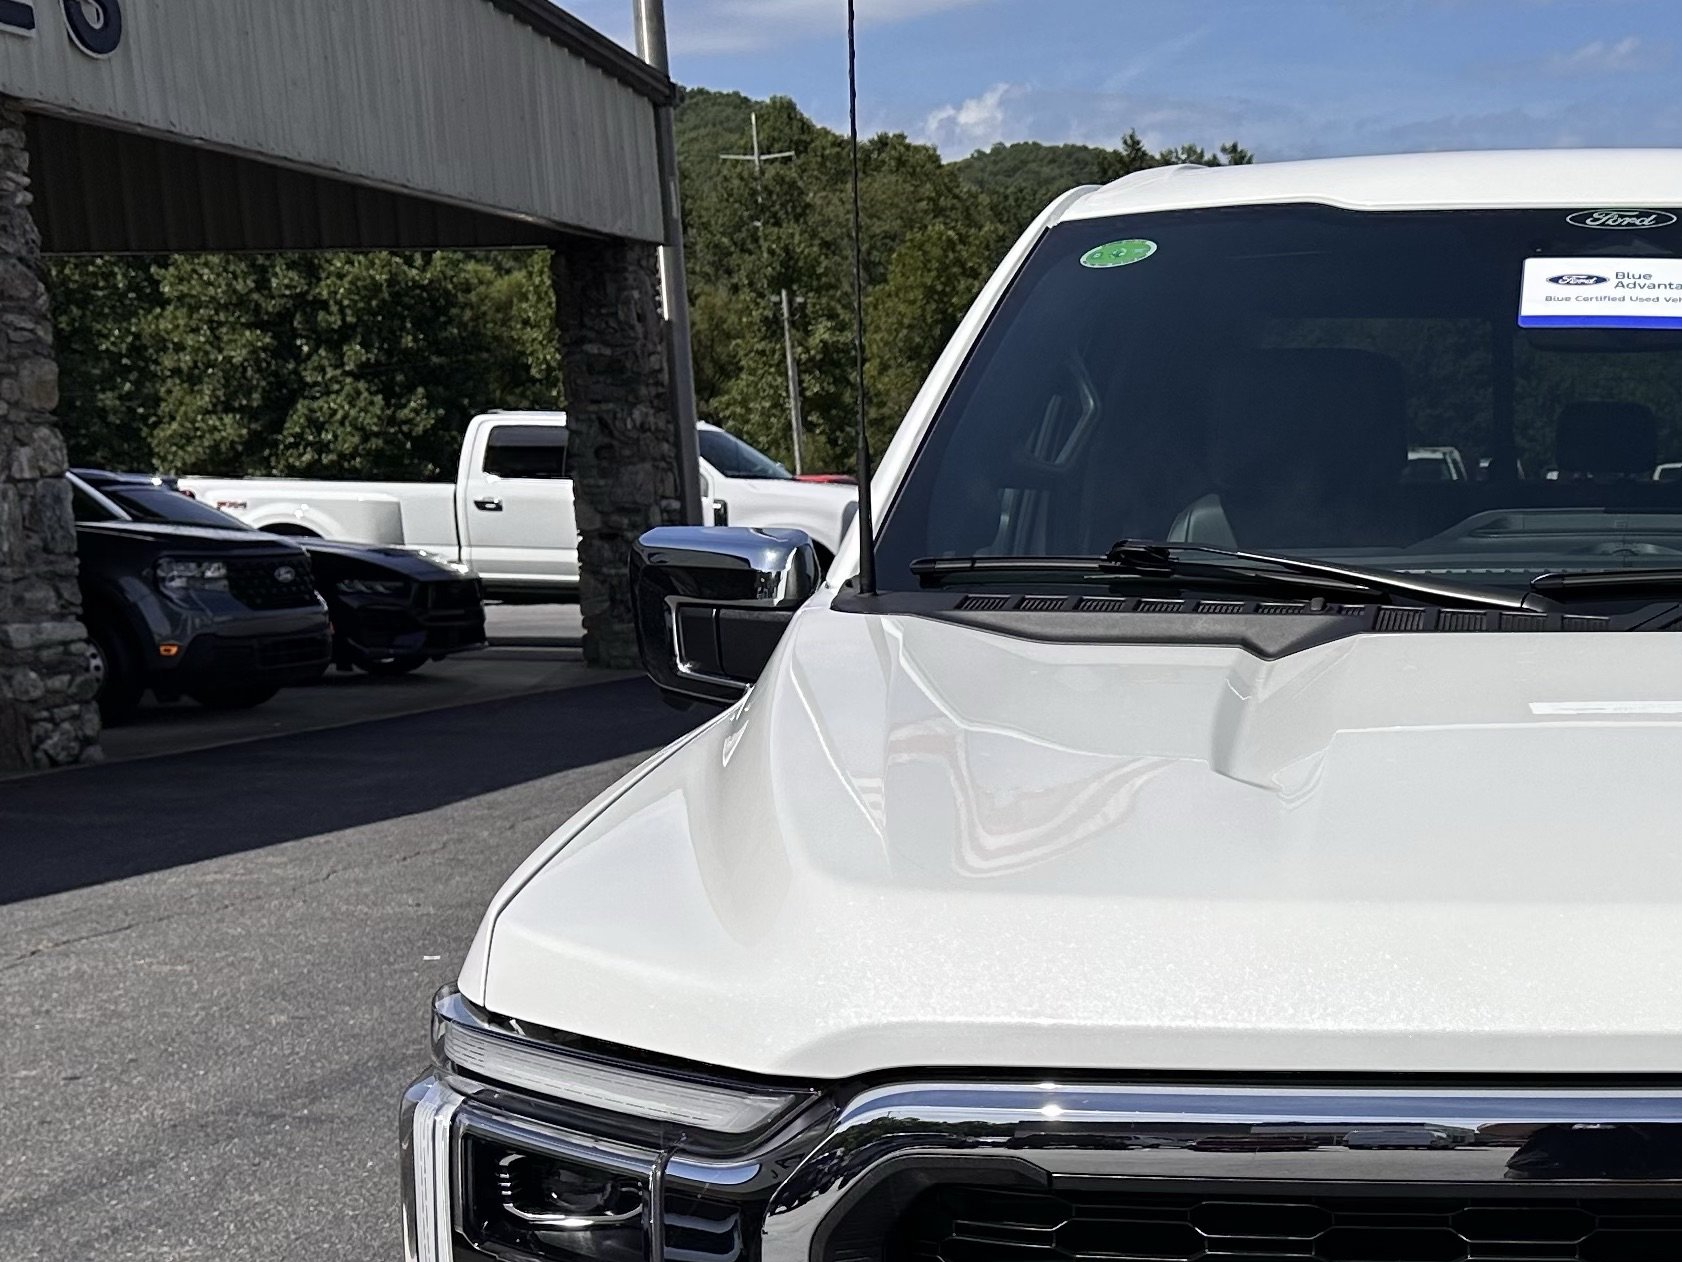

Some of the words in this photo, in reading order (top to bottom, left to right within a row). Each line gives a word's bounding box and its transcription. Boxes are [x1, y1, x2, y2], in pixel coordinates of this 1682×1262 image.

[1585, 209, 1657, 226] Ford
[1558, 275, 1598, 286] Ford
[1615, 271, 1653, 280] Blue
[1575, 295, 1626, 303] Certified
[1630, 295, 1660, 303] Used
